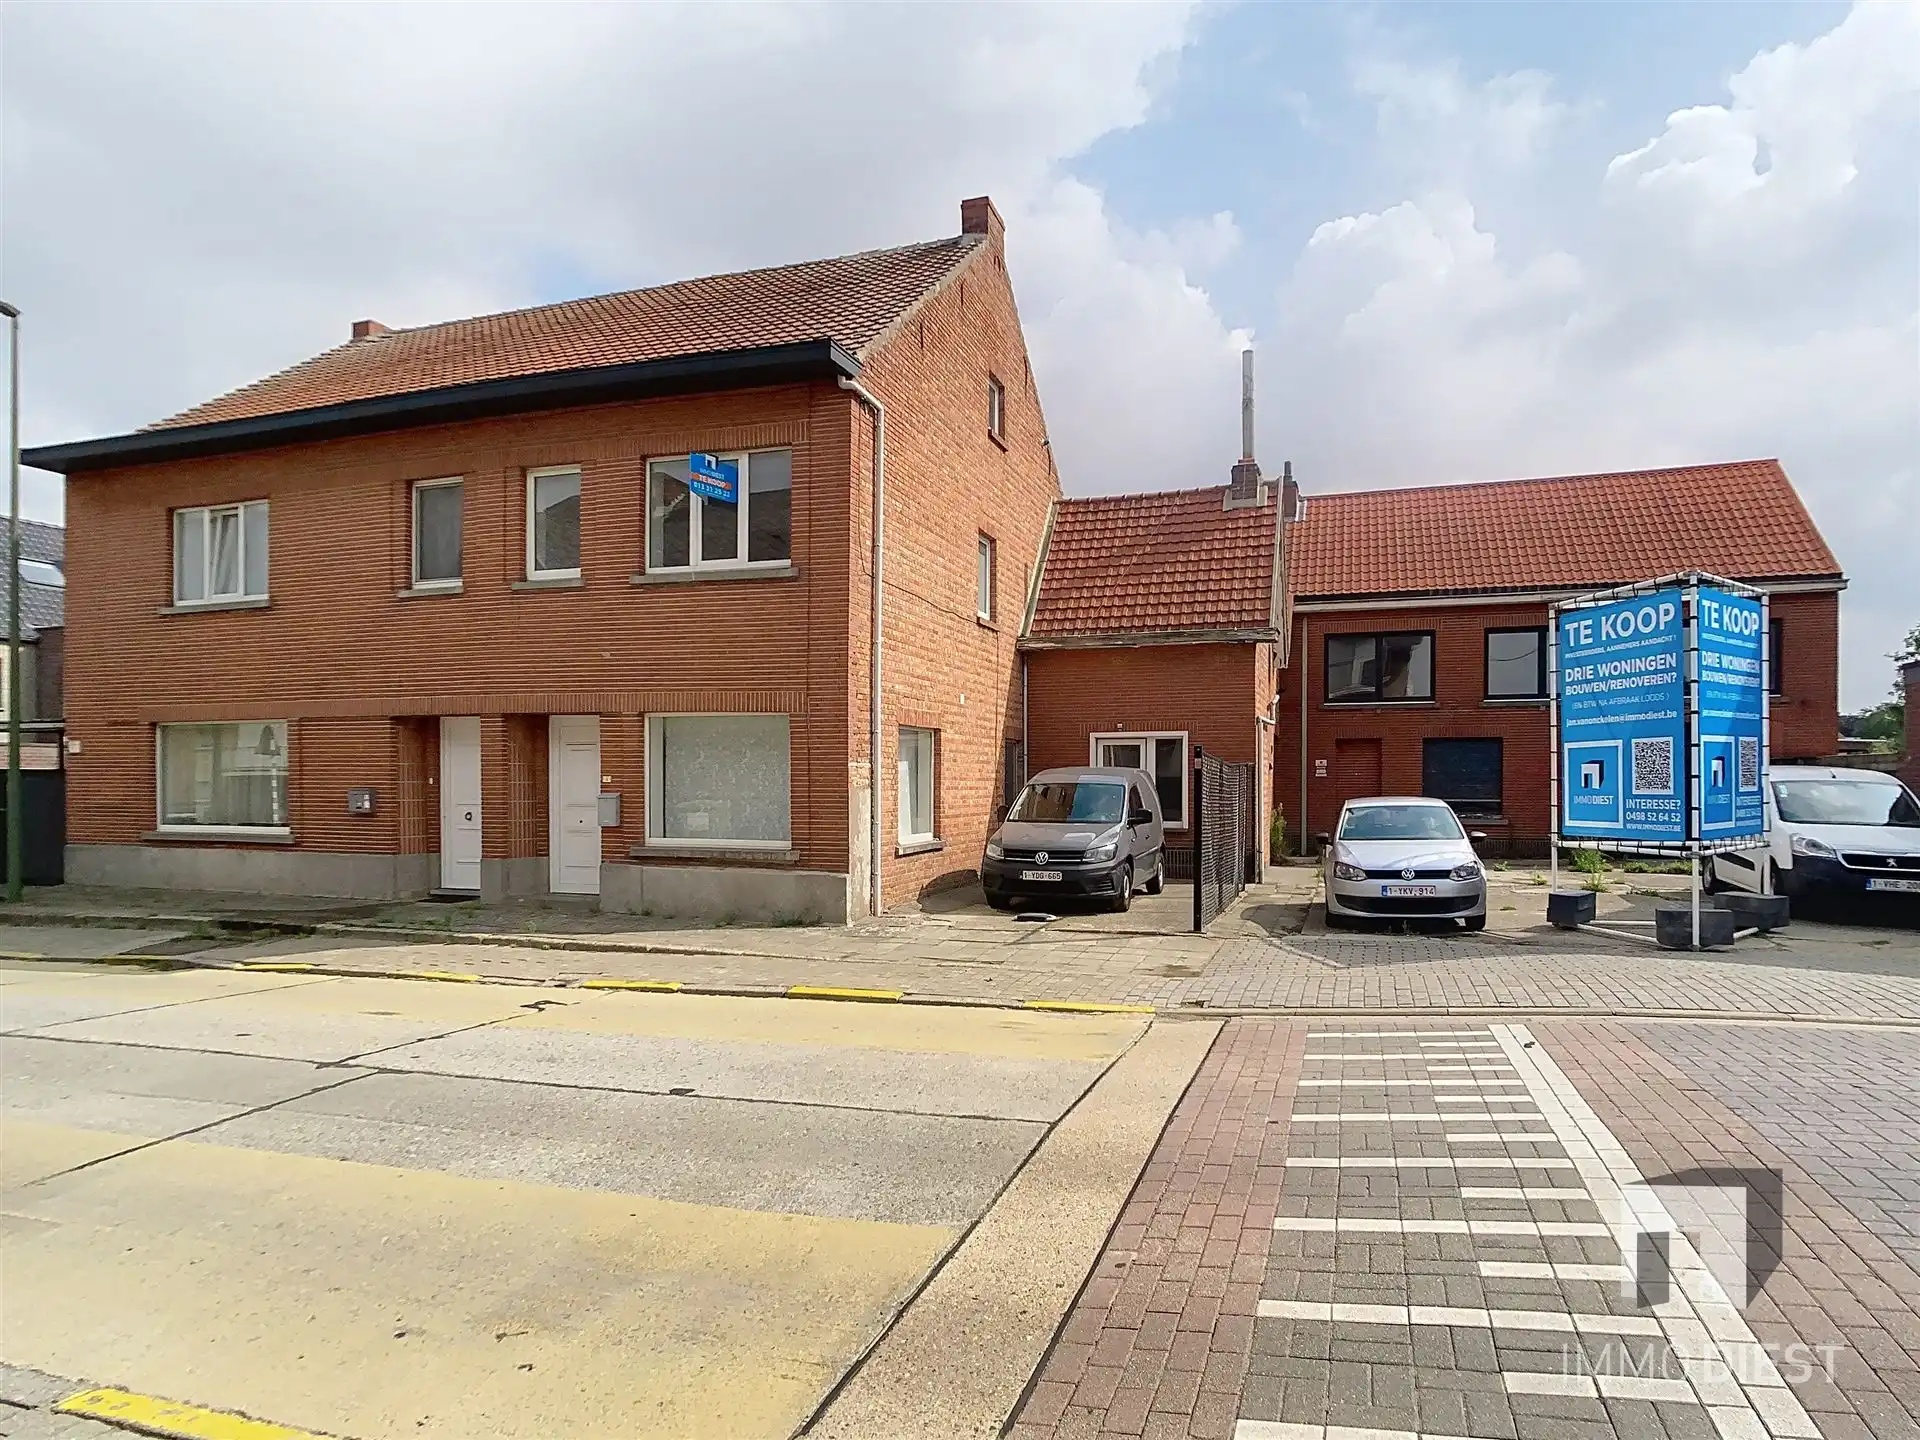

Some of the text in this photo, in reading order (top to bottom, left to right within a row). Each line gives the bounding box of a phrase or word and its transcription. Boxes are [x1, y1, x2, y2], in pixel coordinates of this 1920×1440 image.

[1565, 619, 1593, 647] TE
[1601, 602, 1675, 641] KOOP
[1702, 599, 1759, 637] TE KOOP
[1702, 650, 1720, 667] DRIE
[1565, 652, 1677, 683] DRIE WONINGEN
[1565, 672, 1677, 696] BOUWEN/RENOVEREN?
[1608, 694, 1640, 706] AFBRAAK
[1640, 692, 1665, 702] LOODS
[1573, 795, 1614, 805] IMMODIEST
[1625, 798, 1681, 810] INTERESSE?
[1626, 811, 1681, 822] 0498 52 64 52
